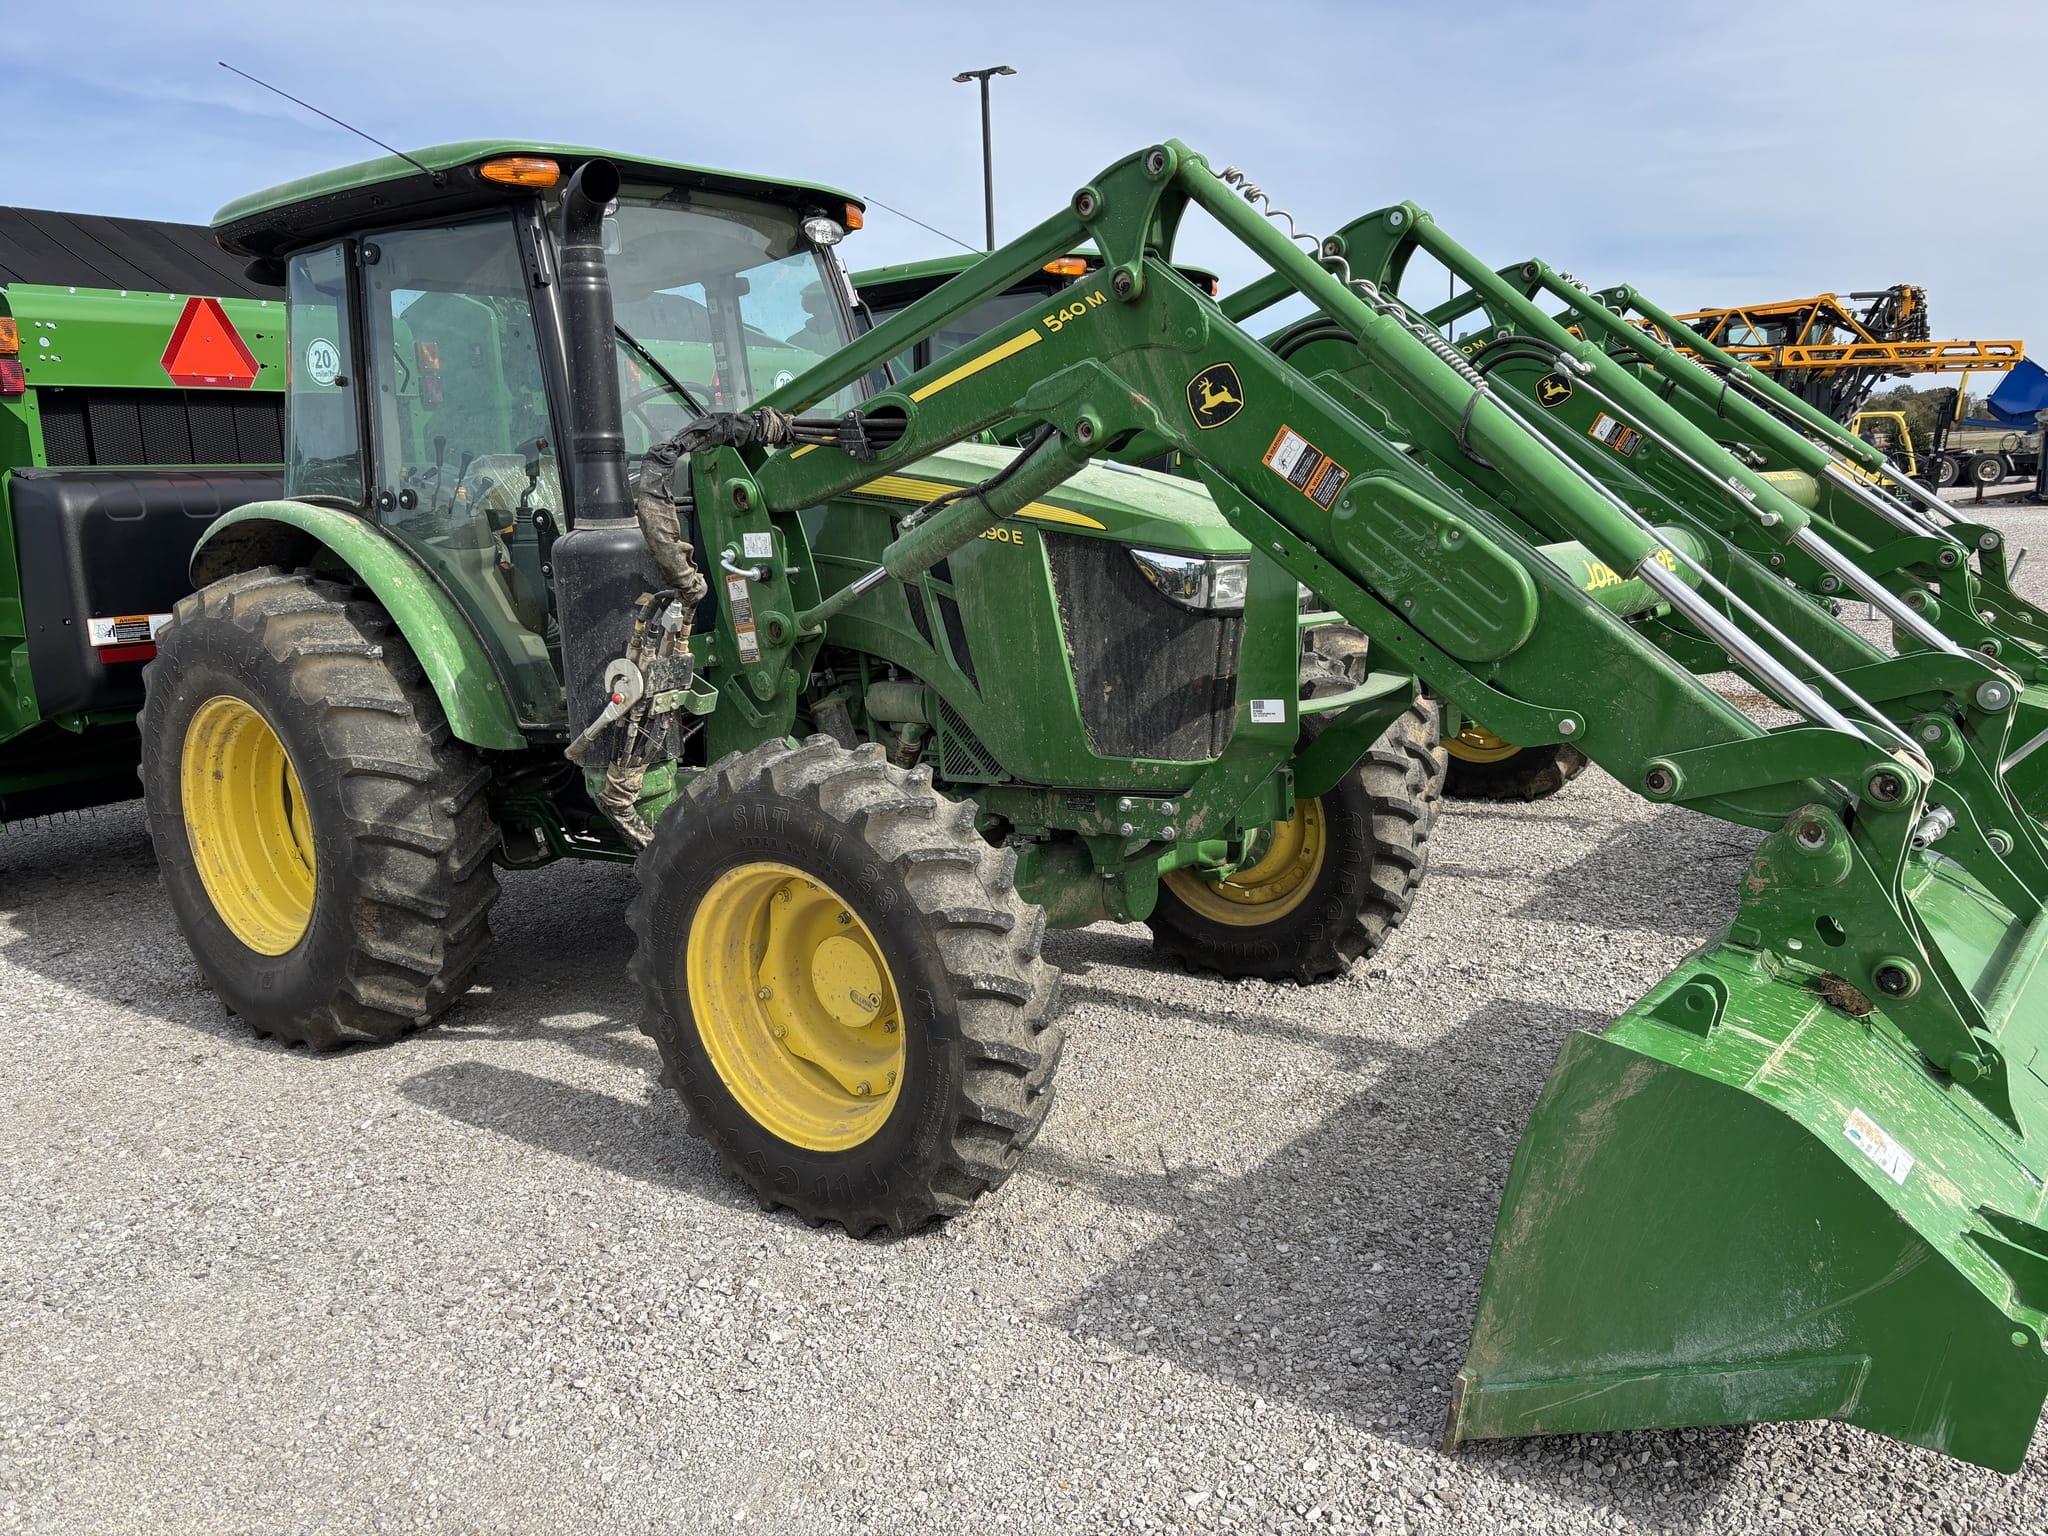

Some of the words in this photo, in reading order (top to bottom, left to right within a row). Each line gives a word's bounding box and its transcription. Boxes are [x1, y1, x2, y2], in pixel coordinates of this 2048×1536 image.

[1041, 302, 1087, 333] 540
[1085, 289, 1108, 308] M
[315, 350, 331, 369] 20
[978, 527, 1010, 543] 90
[1011, 529, 1025, 545] E
[732, 803, 791, 835] SAT
